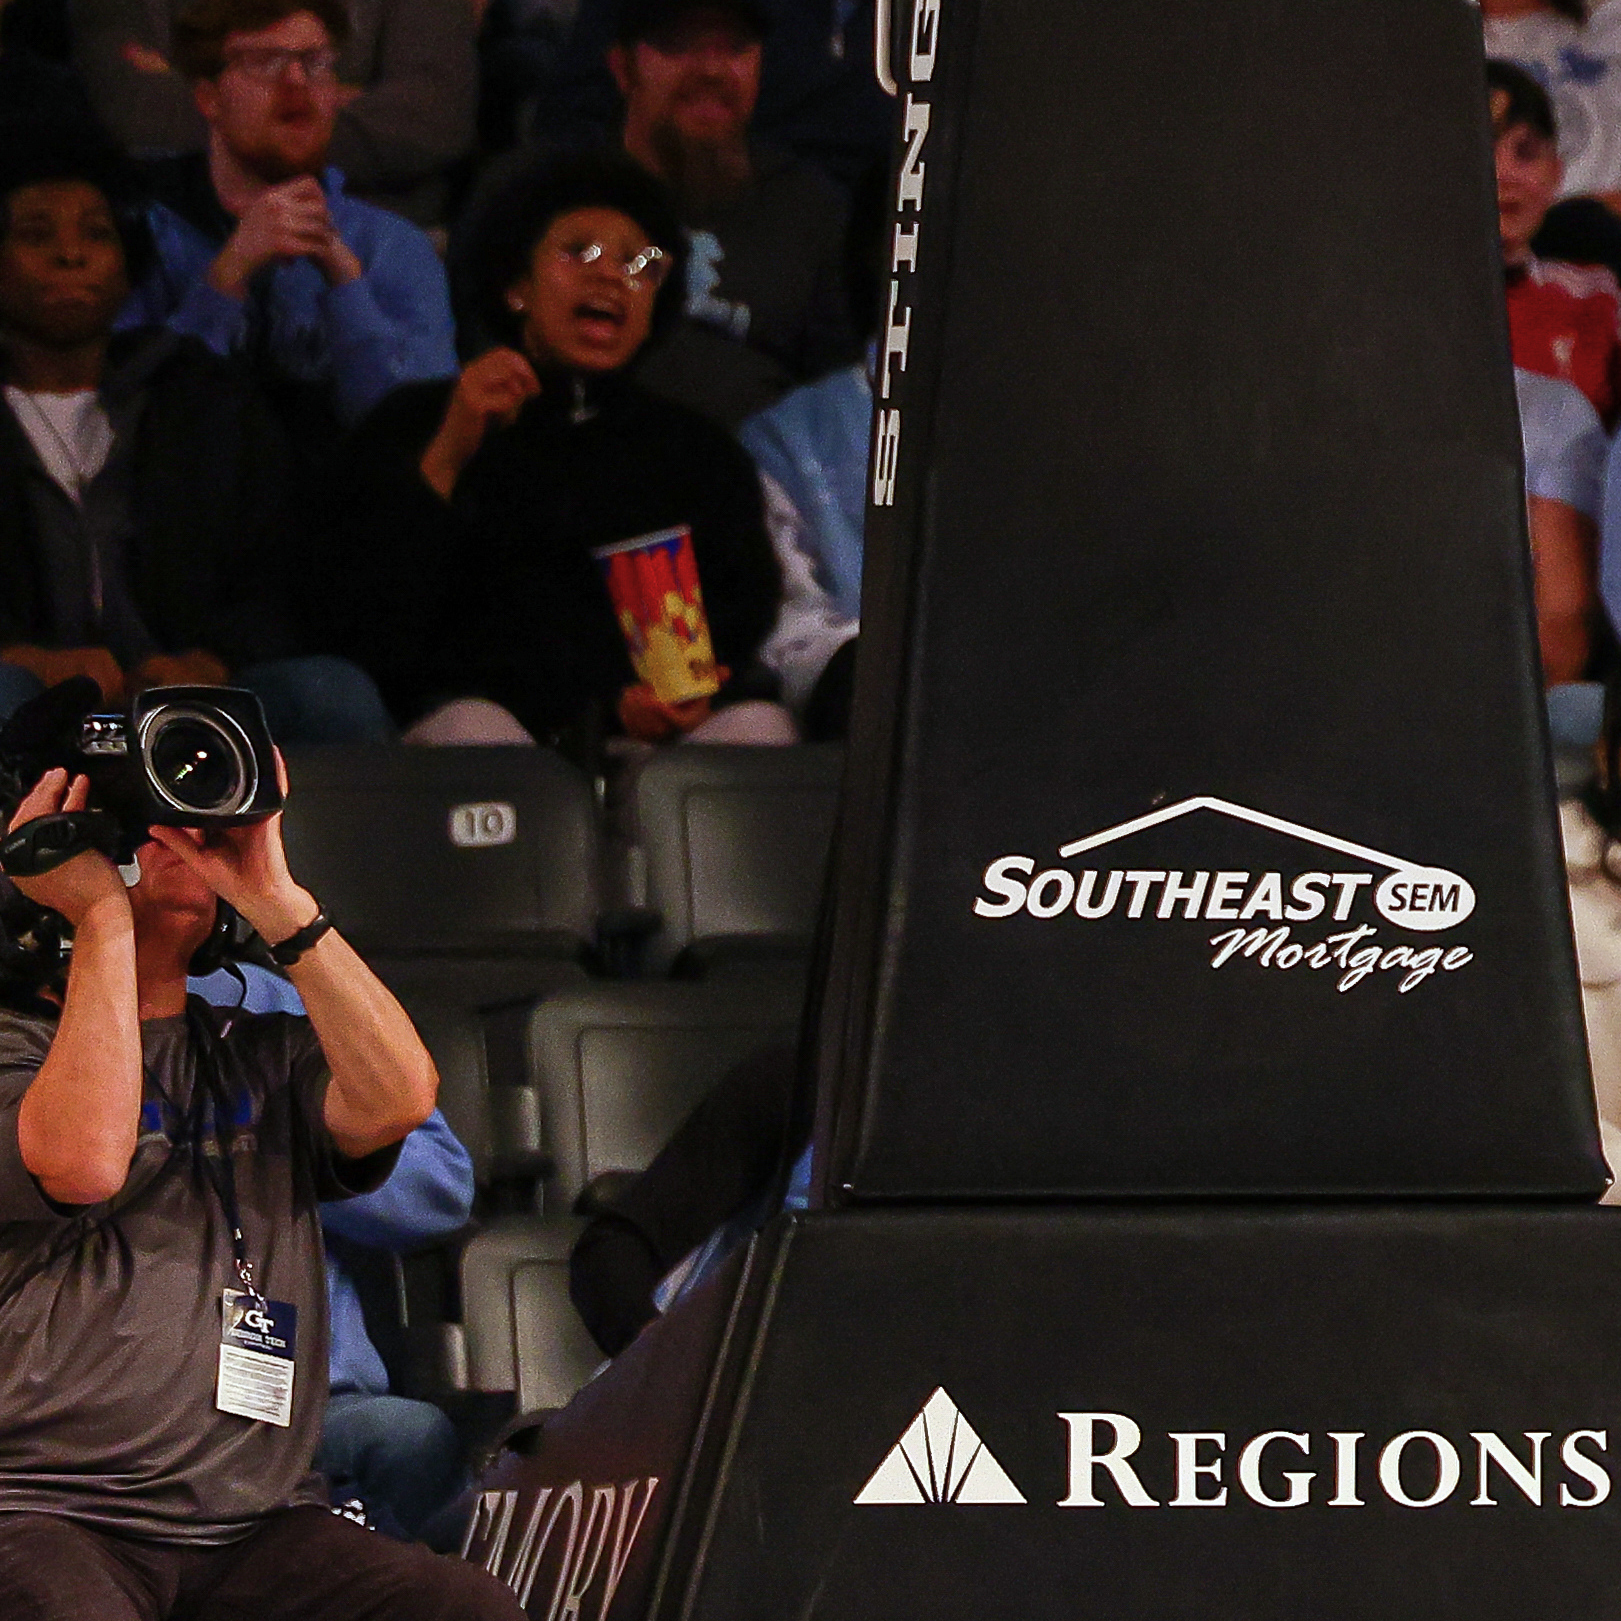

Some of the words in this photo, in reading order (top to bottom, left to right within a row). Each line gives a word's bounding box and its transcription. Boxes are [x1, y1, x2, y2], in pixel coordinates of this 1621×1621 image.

[465, 810, 503, 837] 10
[973, 855, 1373, 921] SOUTHEAST
[1387, 882, 1461, 913] SEM
[1209, 923, 1475, 993] Mortgage
[244, 1309, 275, 1334] GT
[1055, 1411, 1611, 1507] REGIONS
